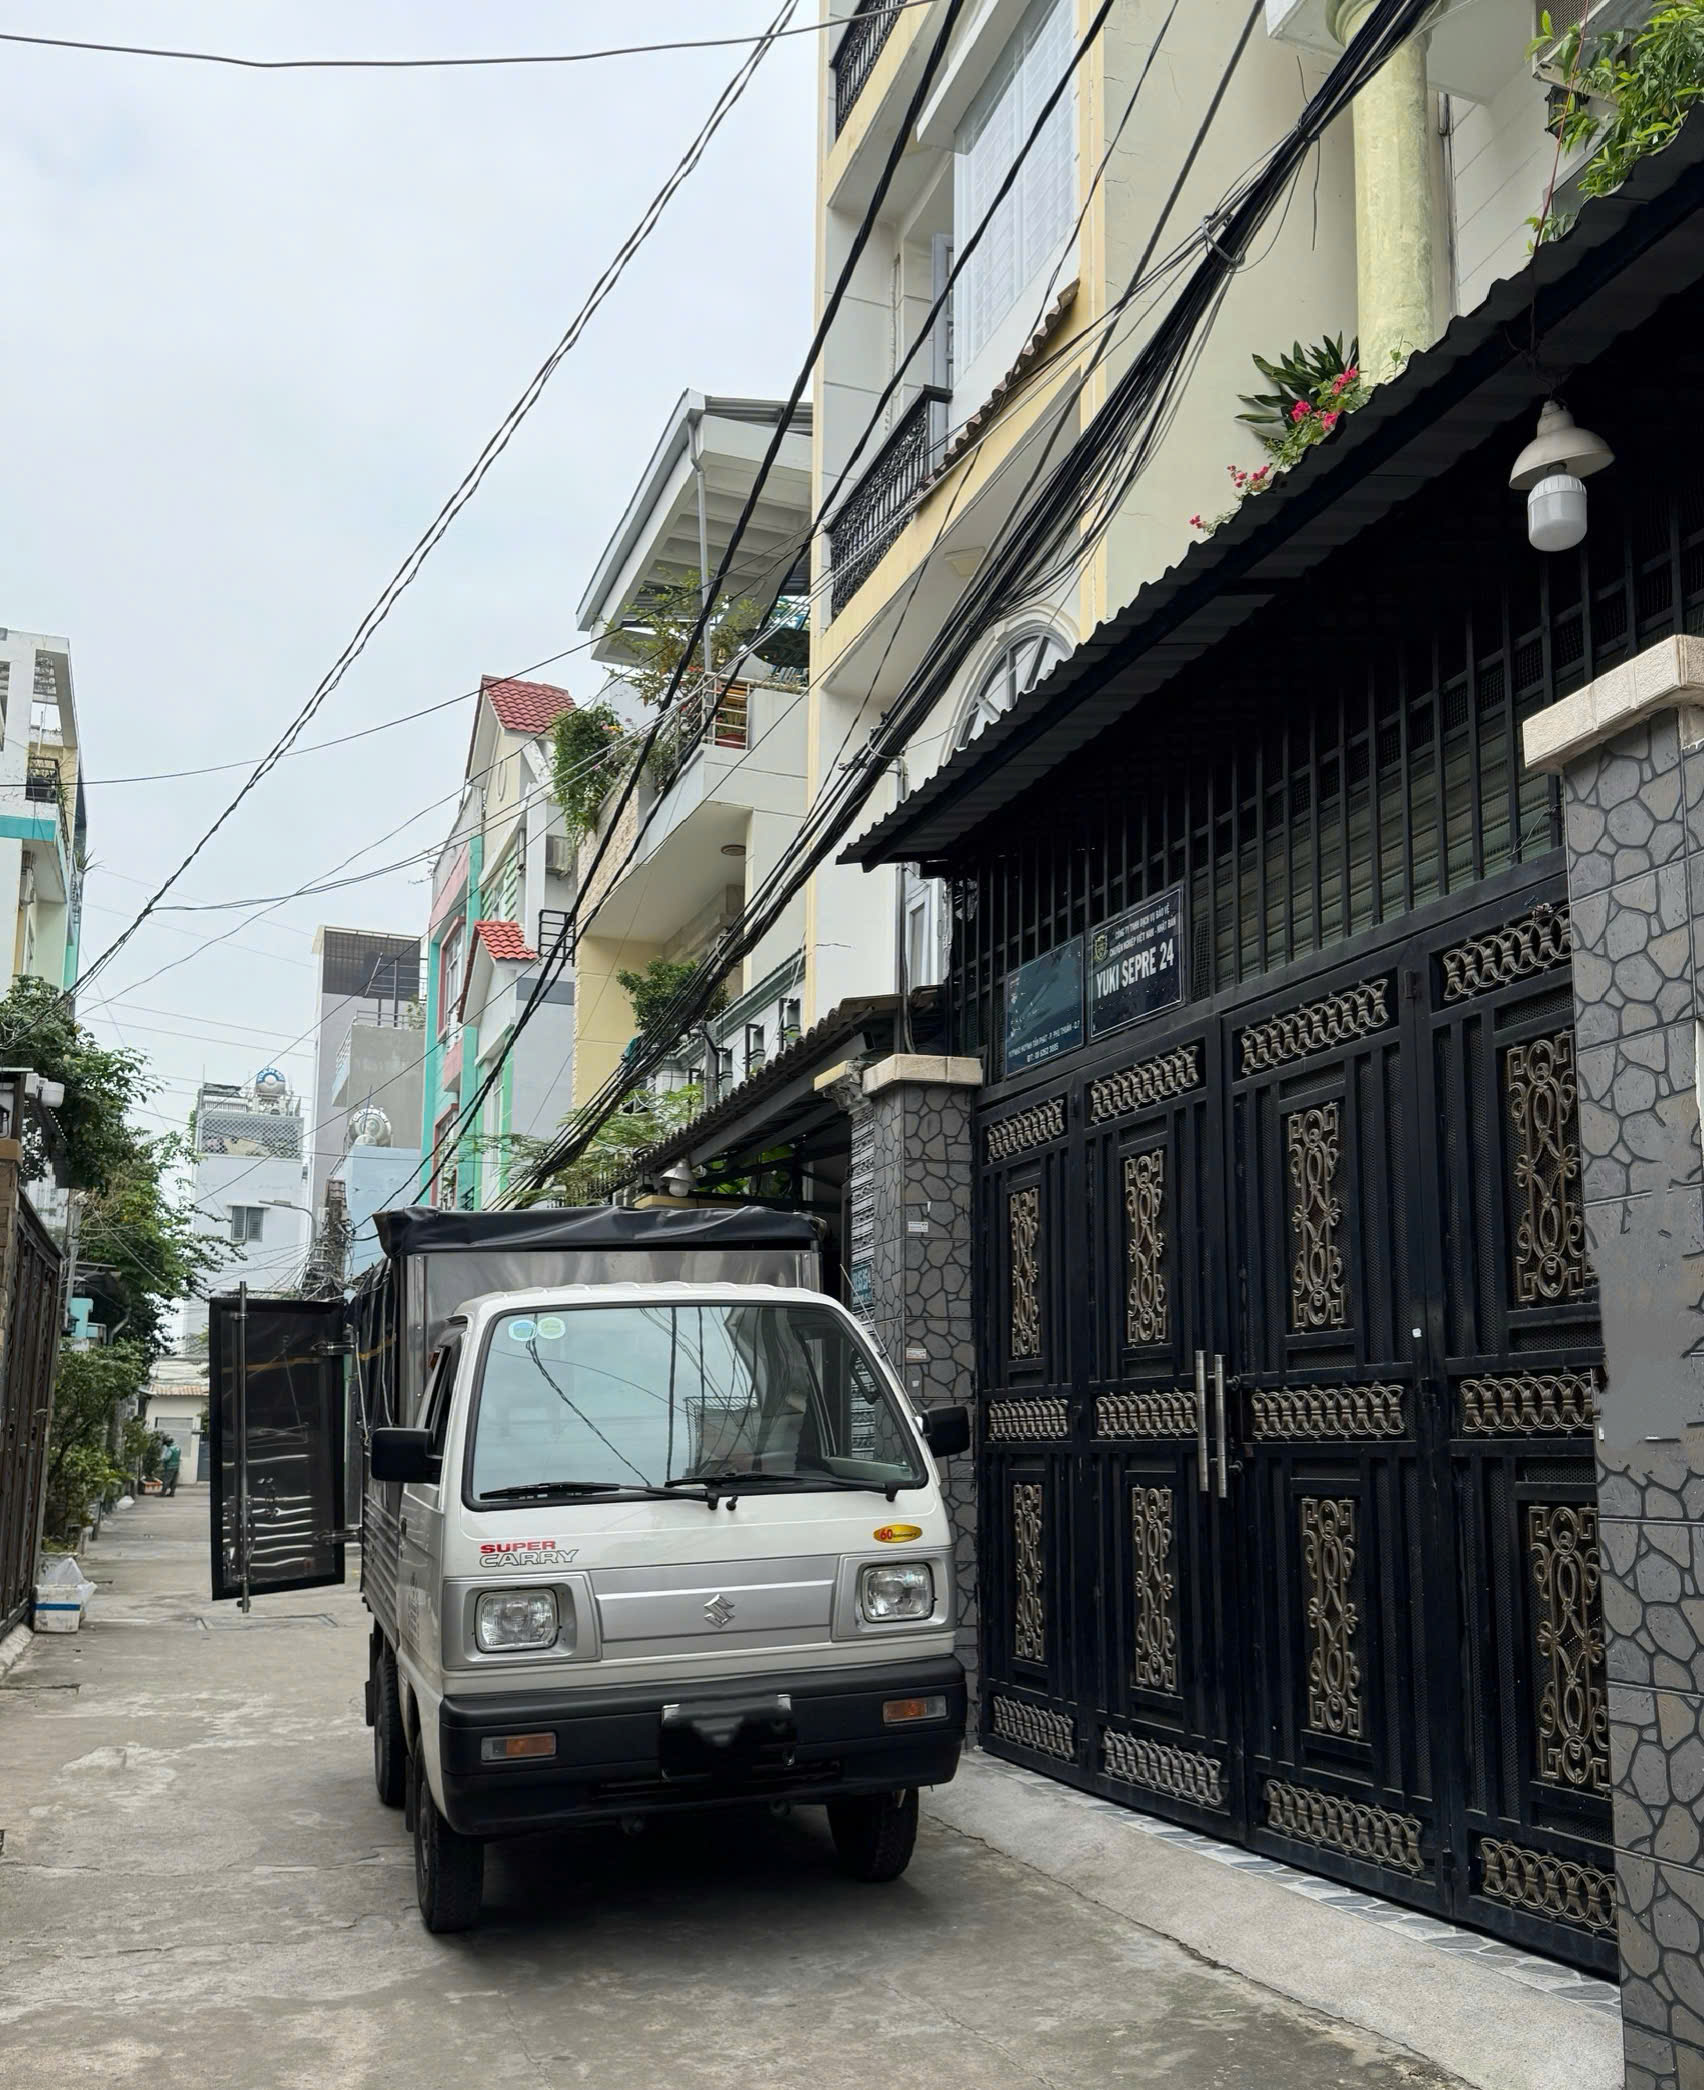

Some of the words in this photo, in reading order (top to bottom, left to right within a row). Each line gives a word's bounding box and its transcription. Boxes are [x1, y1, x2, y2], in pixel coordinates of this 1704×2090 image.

[1096, 964, 1119, 999] YUKI
[1121, 946, 1157, 988] SEPRE
[1159, 938, 1174, 971] 24
[880, 1528, 893, 1540] 60
[480, 1540, 556, 1554] SUPER
[479, 1549, 579, 1568] CARRY
